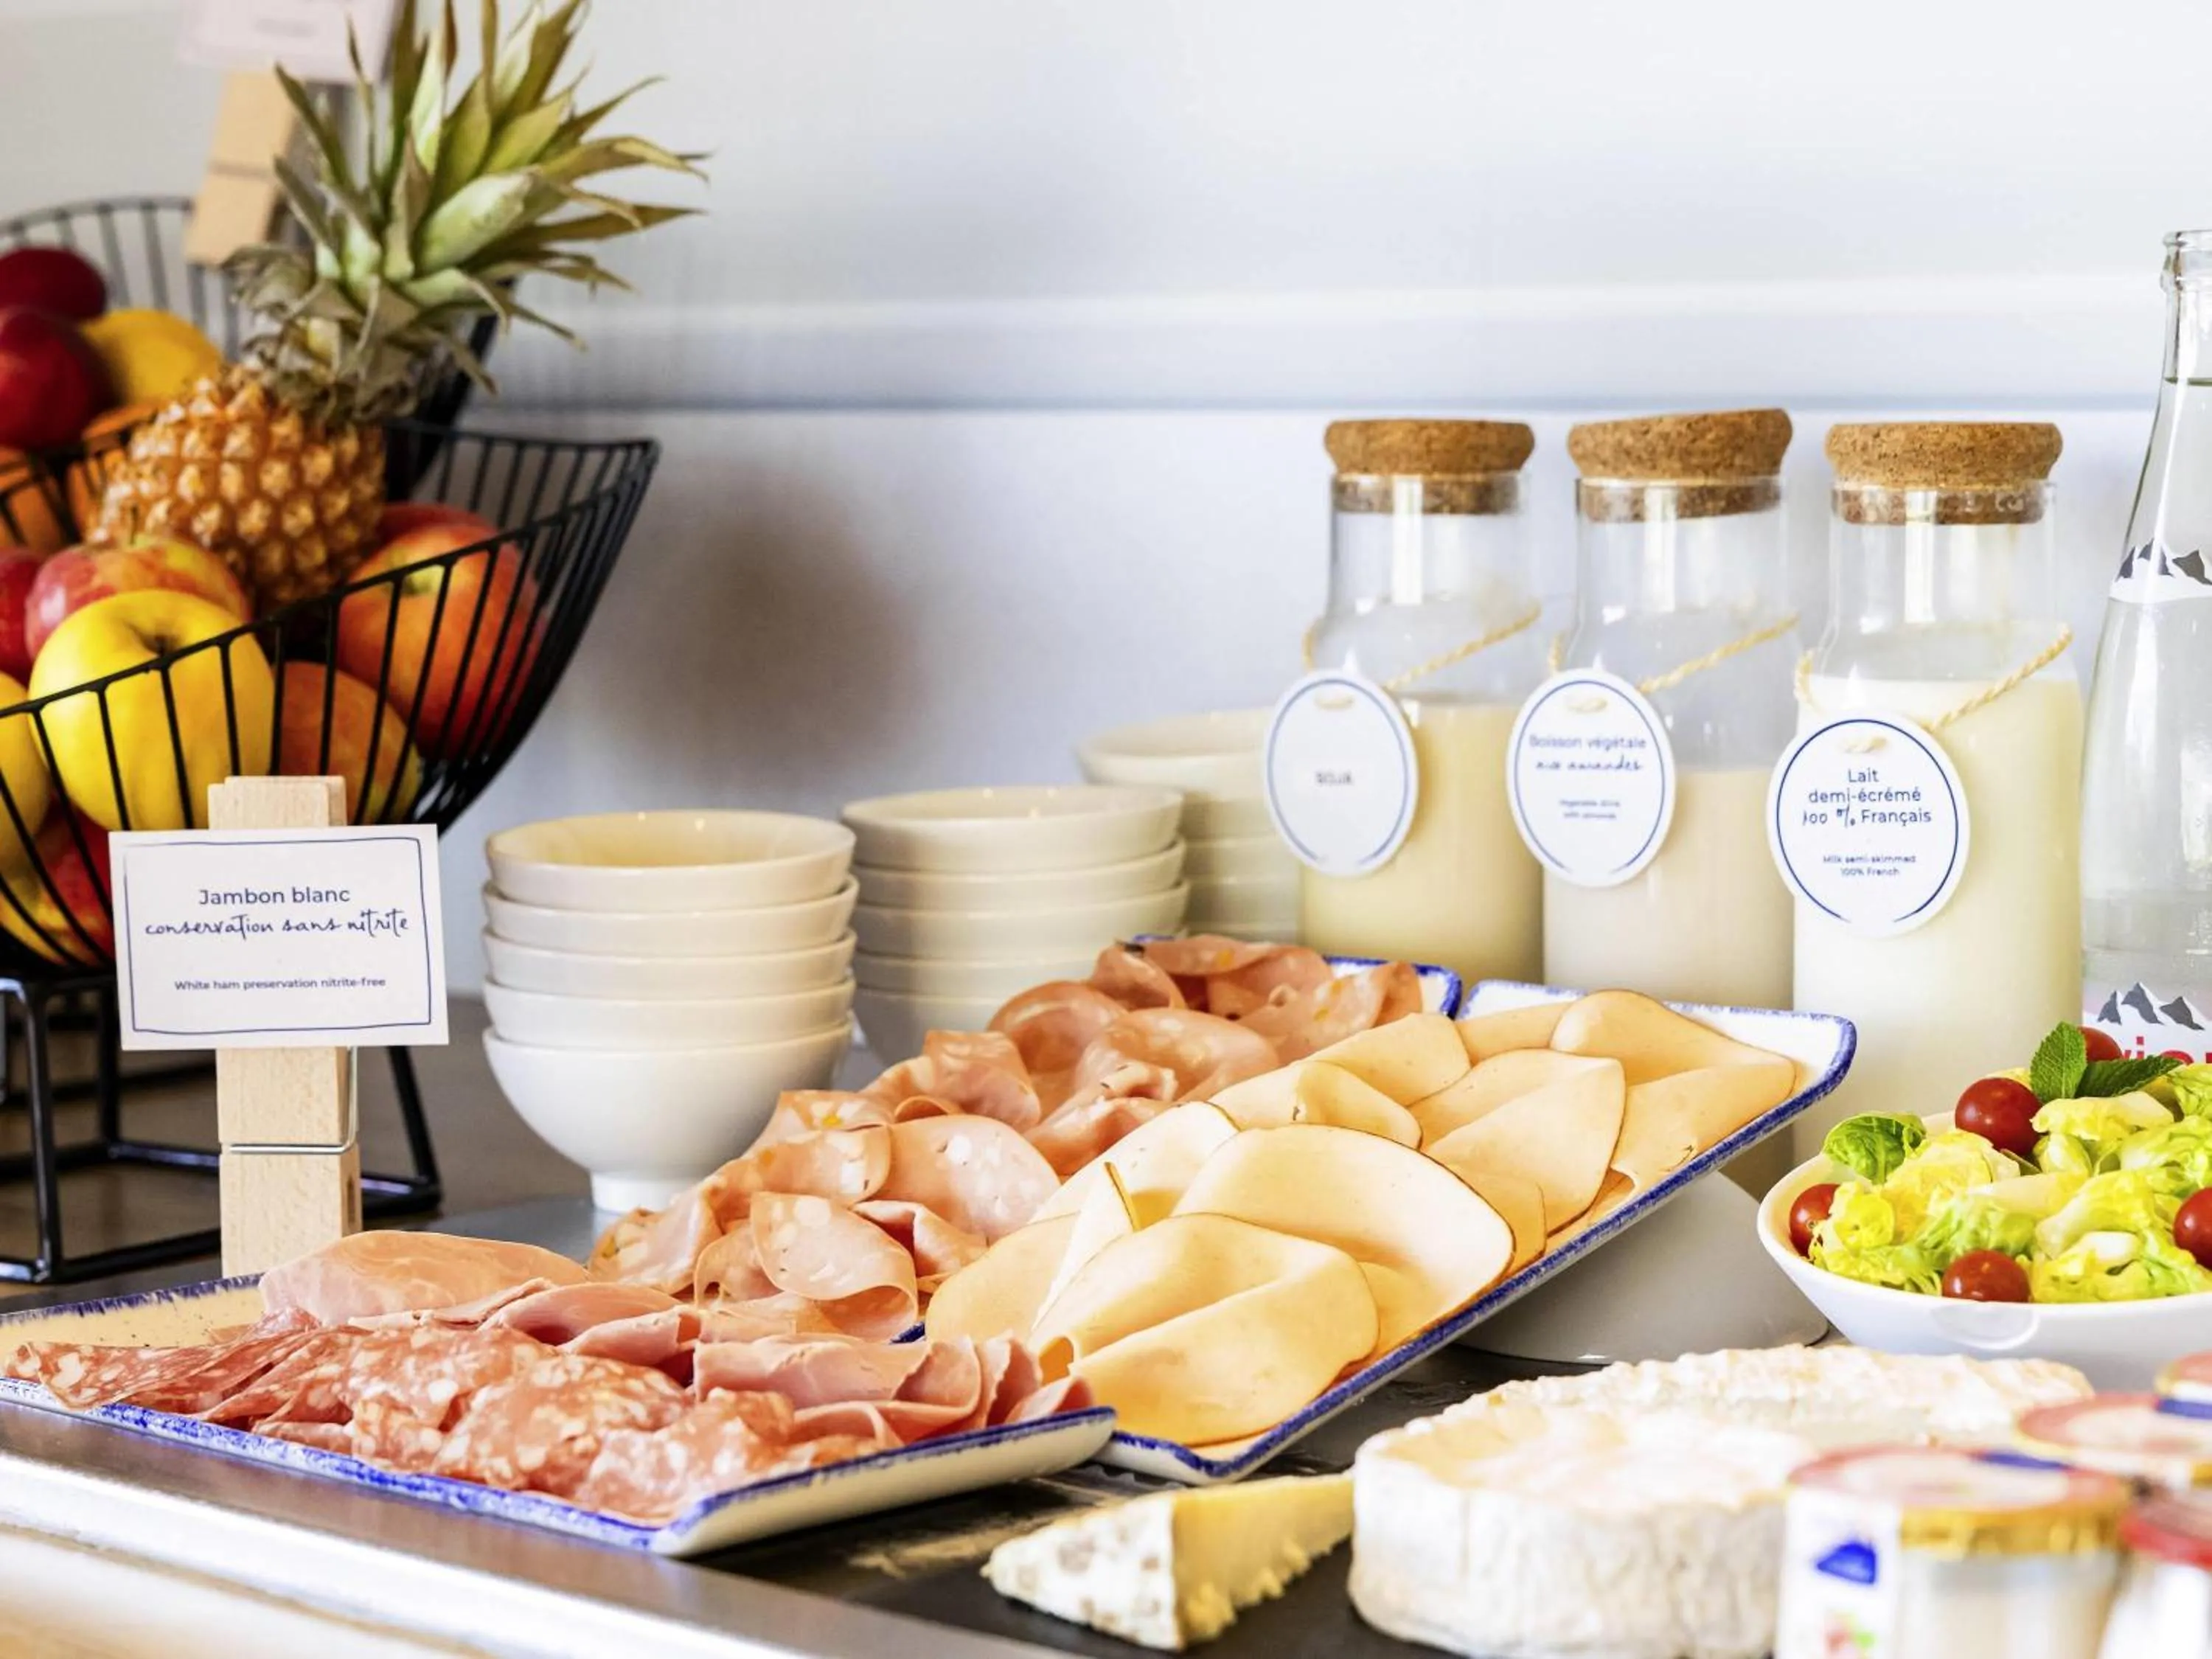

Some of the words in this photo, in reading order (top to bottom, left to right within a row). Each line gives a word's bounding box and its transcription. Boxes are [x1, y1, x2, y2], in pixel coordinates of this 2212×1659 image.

[1848, 768, 1879, 784] Lait
[1808, 786, 1921, 804] demi-écrémé
[1860, 807, 1932, 827] Français
[1867, 867, 1900, 876] French
[198, 888, 285, 906] Jambon
[292, 886, 351, 903] blanc
[145, 913, 274, 940] conservation
[281, 917, 342, 932] sans
[347, 908, 409, 938] nitrite
[174, 980, 210, 991] White
[213, 978, 241, 990] ham
[243, 977, 319, 992] preservation
[321, 975, 386, 988] nitrite-free
